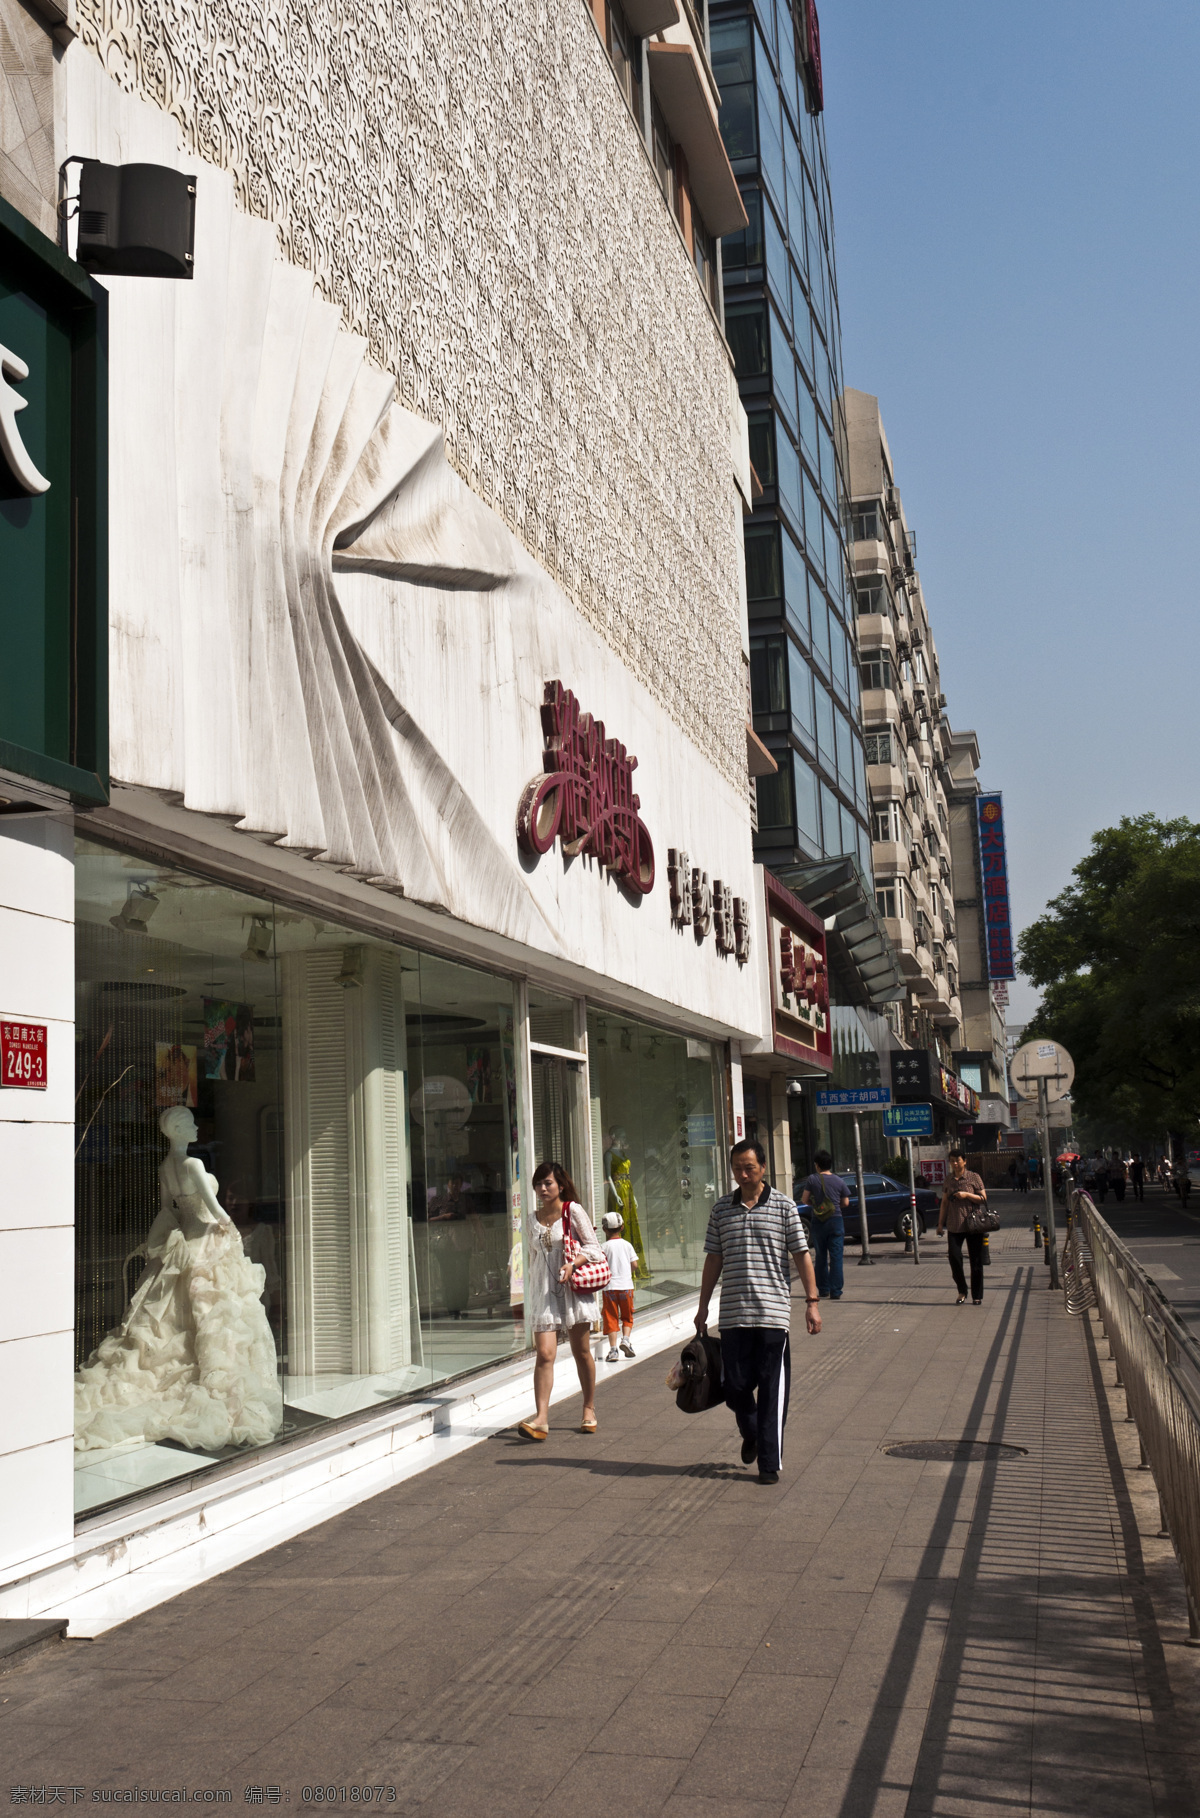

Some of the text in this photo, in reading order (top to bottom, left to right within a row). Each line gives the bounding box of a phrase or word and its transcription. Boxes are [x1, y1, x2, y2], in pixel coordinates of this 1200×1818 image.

[981, 826, 1009, 922] 大万酒店
[4, 1025, 44, 1043] 东四南大街
[7, 1050, 43, 1080] 249-3
[895, 1060, 920, 1069] 美容
[828, 1090, 879, 1104] 西堂子胡同
